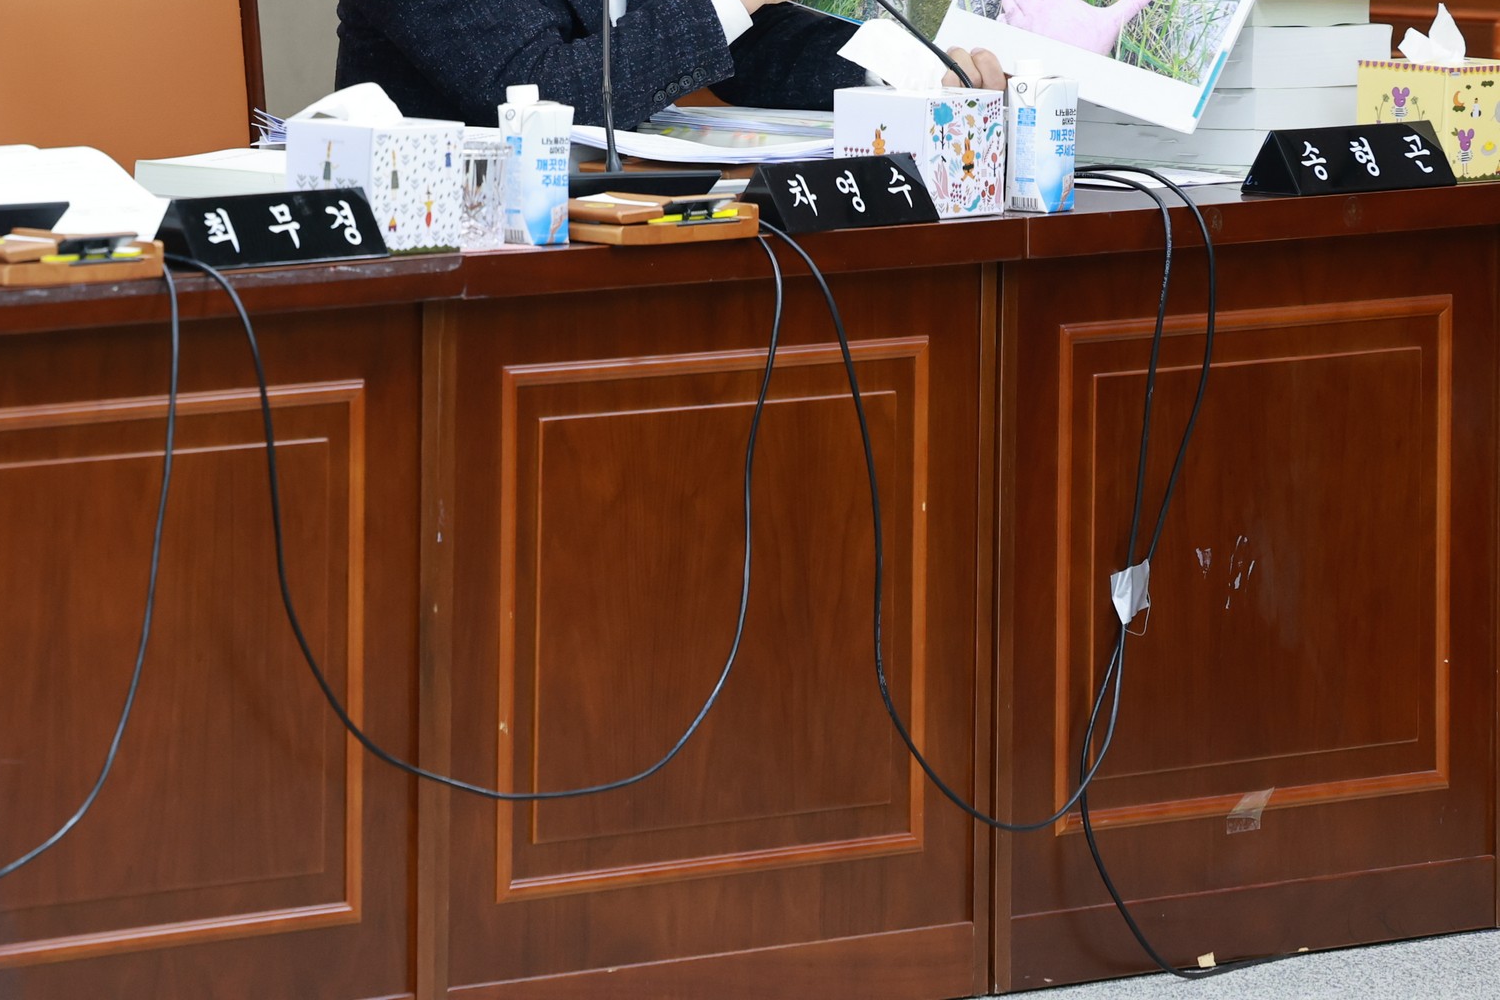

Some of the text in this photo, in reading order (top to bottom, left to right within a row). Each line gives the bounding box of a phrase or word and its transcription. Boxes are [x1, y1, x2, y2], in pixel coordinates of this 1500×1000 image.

[1301, 134, 1434, 181] 송형곤
[787, 166, 913, 217] 차영수
[204, 200, 363, 254] 최무경
